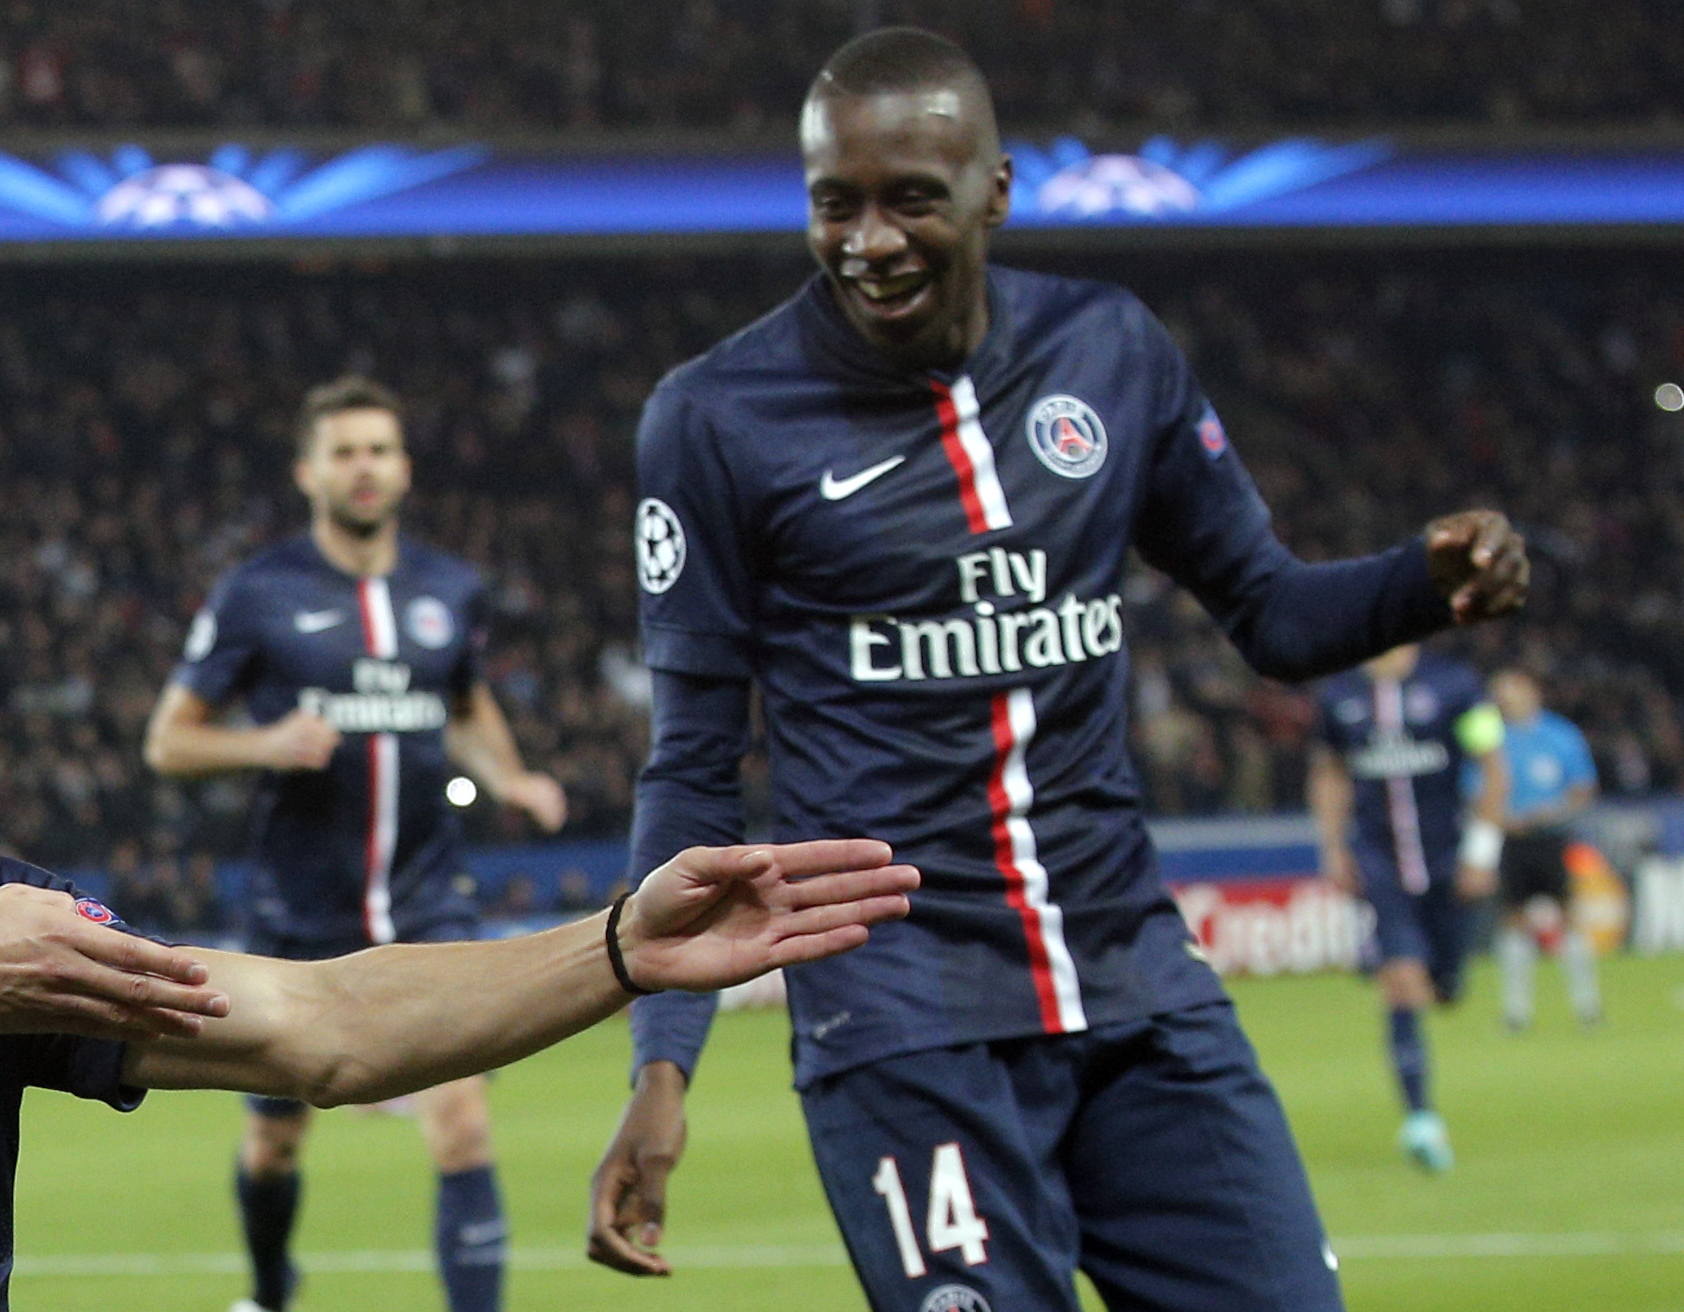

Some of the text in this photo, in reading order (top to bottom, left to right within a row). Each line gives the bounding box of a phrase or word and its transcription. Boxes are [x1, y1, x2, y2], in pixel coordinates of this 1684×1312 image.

[956, 546, 1047, 603] Fly
[850, 592, 1123, 681] Emirates
[872, 1141, 989, 1279] 14
